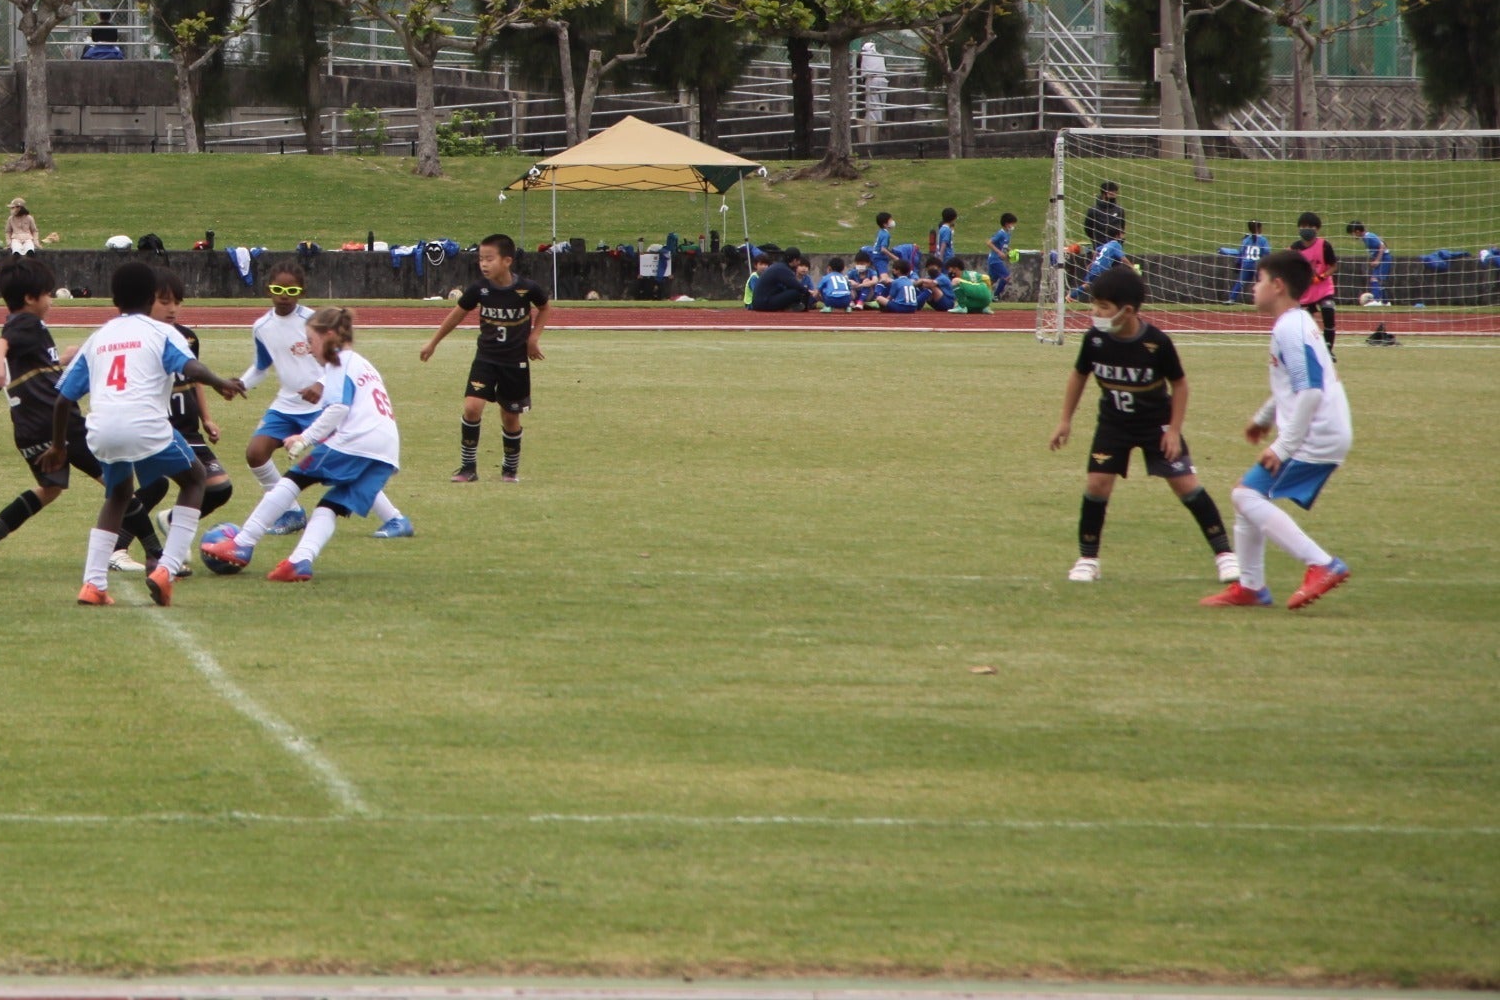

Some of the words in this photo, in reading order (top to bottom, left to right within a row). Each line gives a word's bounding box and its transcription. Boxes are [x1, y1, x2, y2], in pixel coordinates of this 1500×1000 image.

[830, 275, 850, 291] 14
[903, 285, 918, 304] 10
[481, 306, 526, 320] ZELVA
[496, 326, 508, 343] 3
[105, 354, 128, 392] 4
[1091, 361, 1155, 383] ZELVA
[1110, 389, 1136, 414] 12
